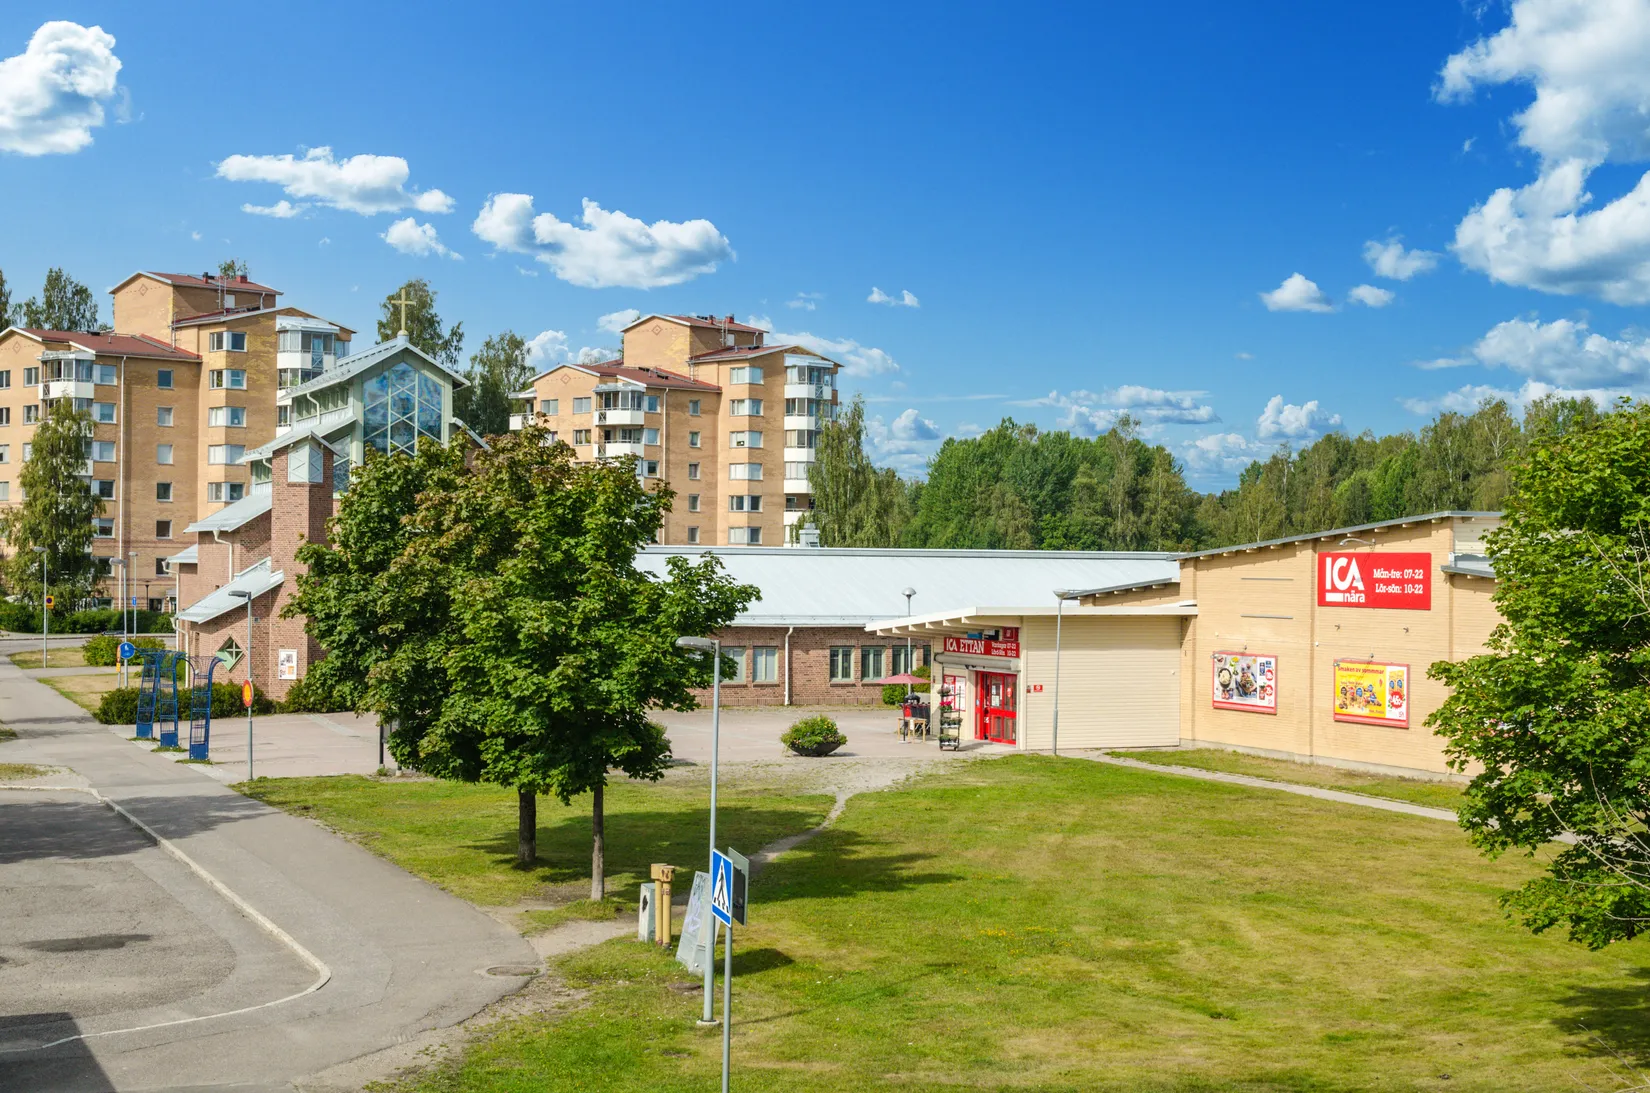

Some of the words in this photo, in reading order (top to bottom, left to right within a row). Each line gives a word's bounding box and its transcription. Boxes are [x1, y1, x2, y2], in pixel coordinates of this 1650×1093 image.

[1325, 557, 1365, 590] ICA
[1373, 568, 1402, 579] Mån-fre:
[1404, 569, 1423, 579] 07-22
[1375, 583, 1402, 593] Lör-sön:
[1404, 584, 1423, 594] 10-22
[1344, 590, 1365, 603] nära
[946, 638, 958, 652] ICA
[960, 639, 985, 654] ETTAN
